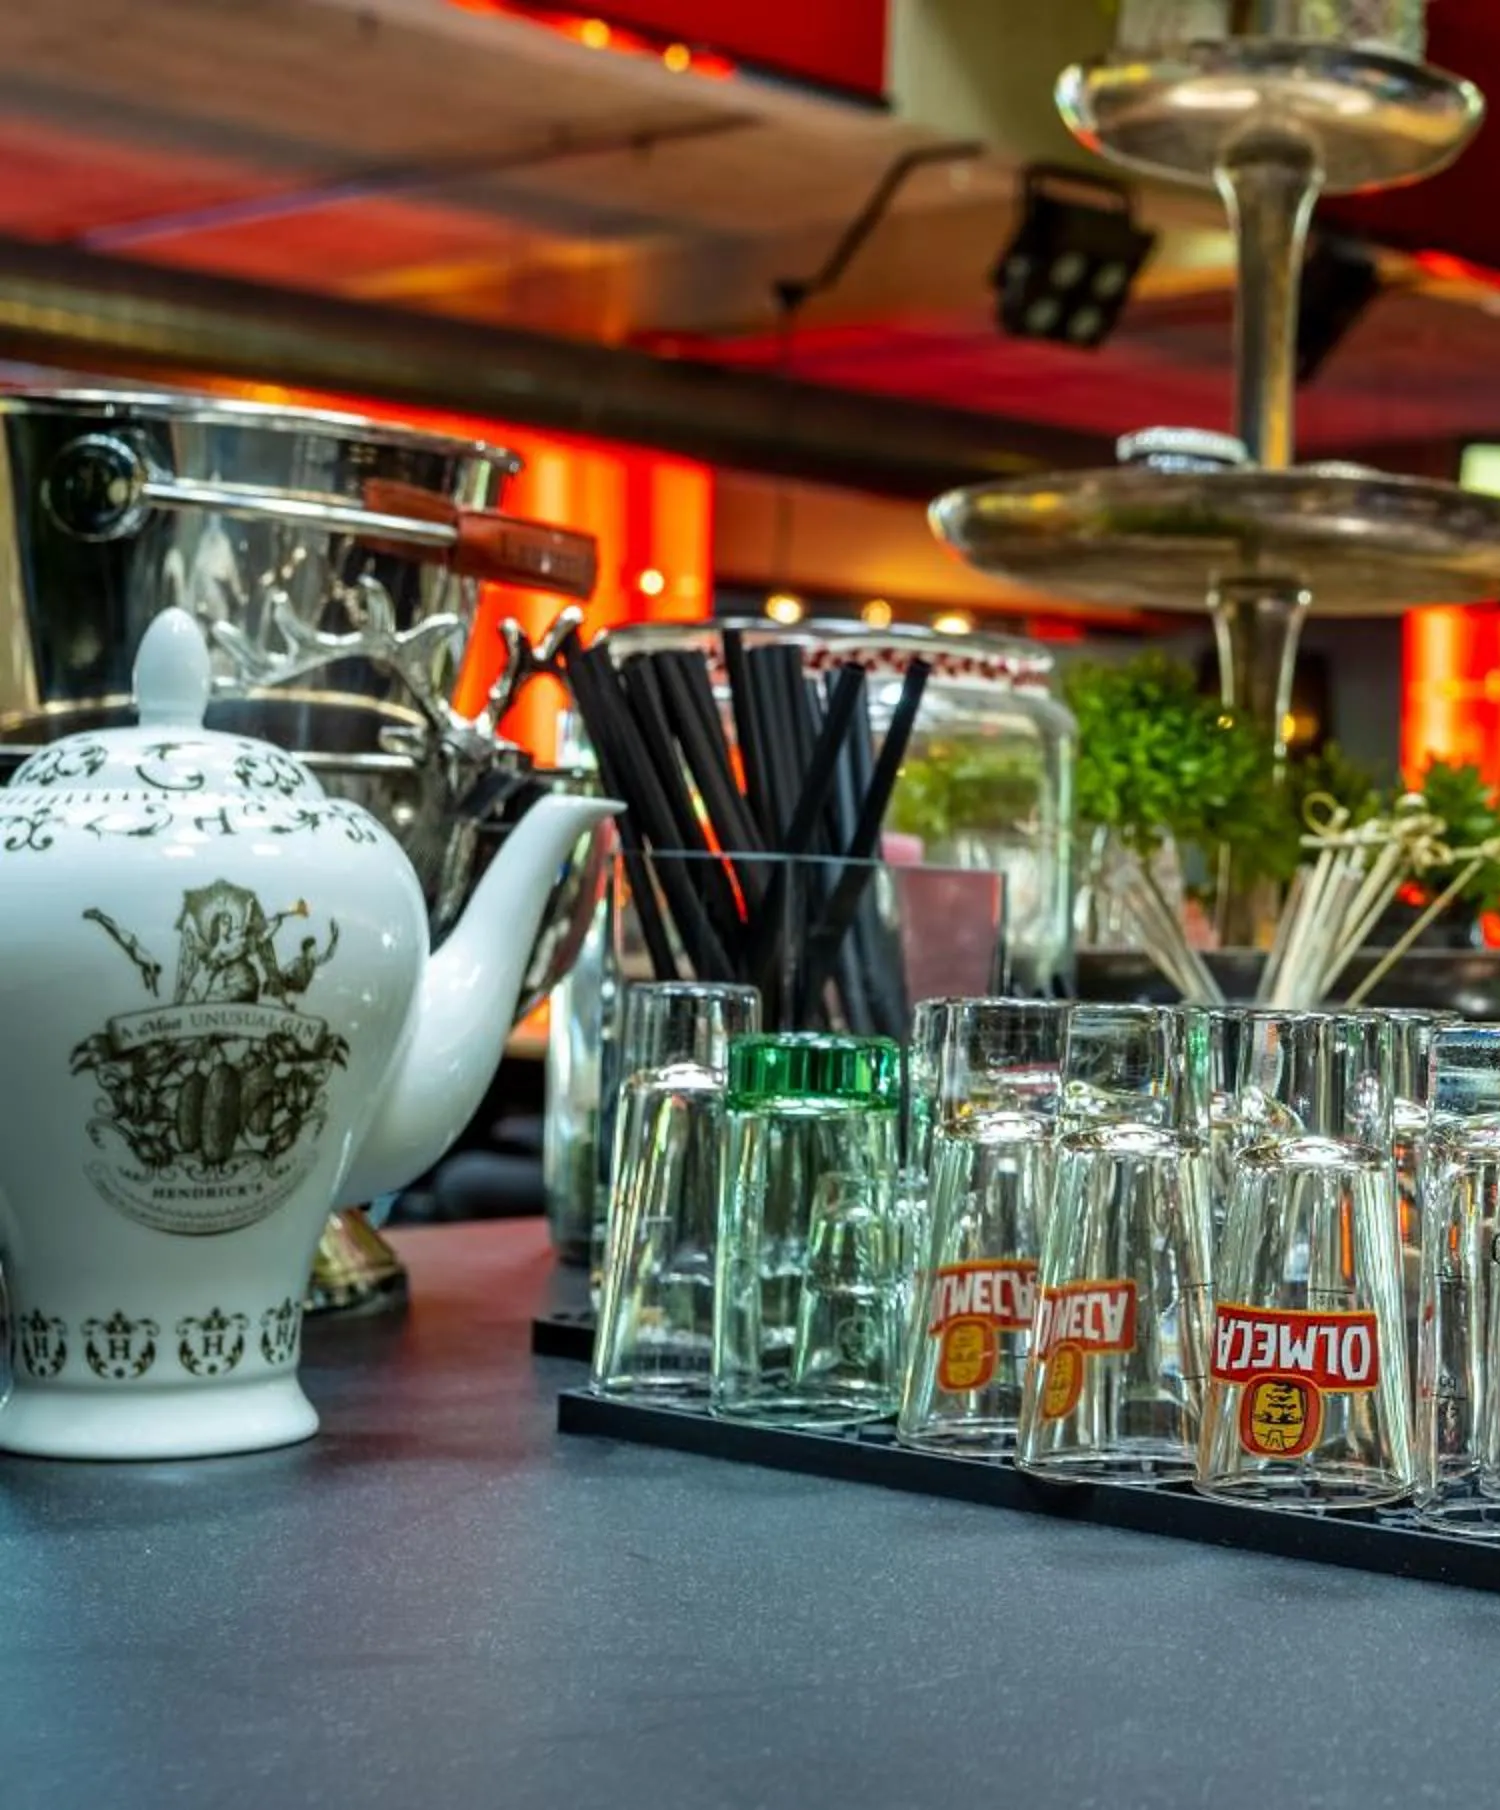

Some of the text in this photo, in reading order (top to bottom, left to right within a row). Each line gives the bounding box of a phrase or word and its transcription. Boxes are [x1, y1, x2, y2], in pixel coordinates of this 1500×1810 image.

[190, 1010, 276, 1029] UNUSUAL
[279, 1016, 318, 1041] GIN
[151, 1182, 264, 1200] HENDRICK'S
[1215, 1315, 1372, 1382] OLMECA
